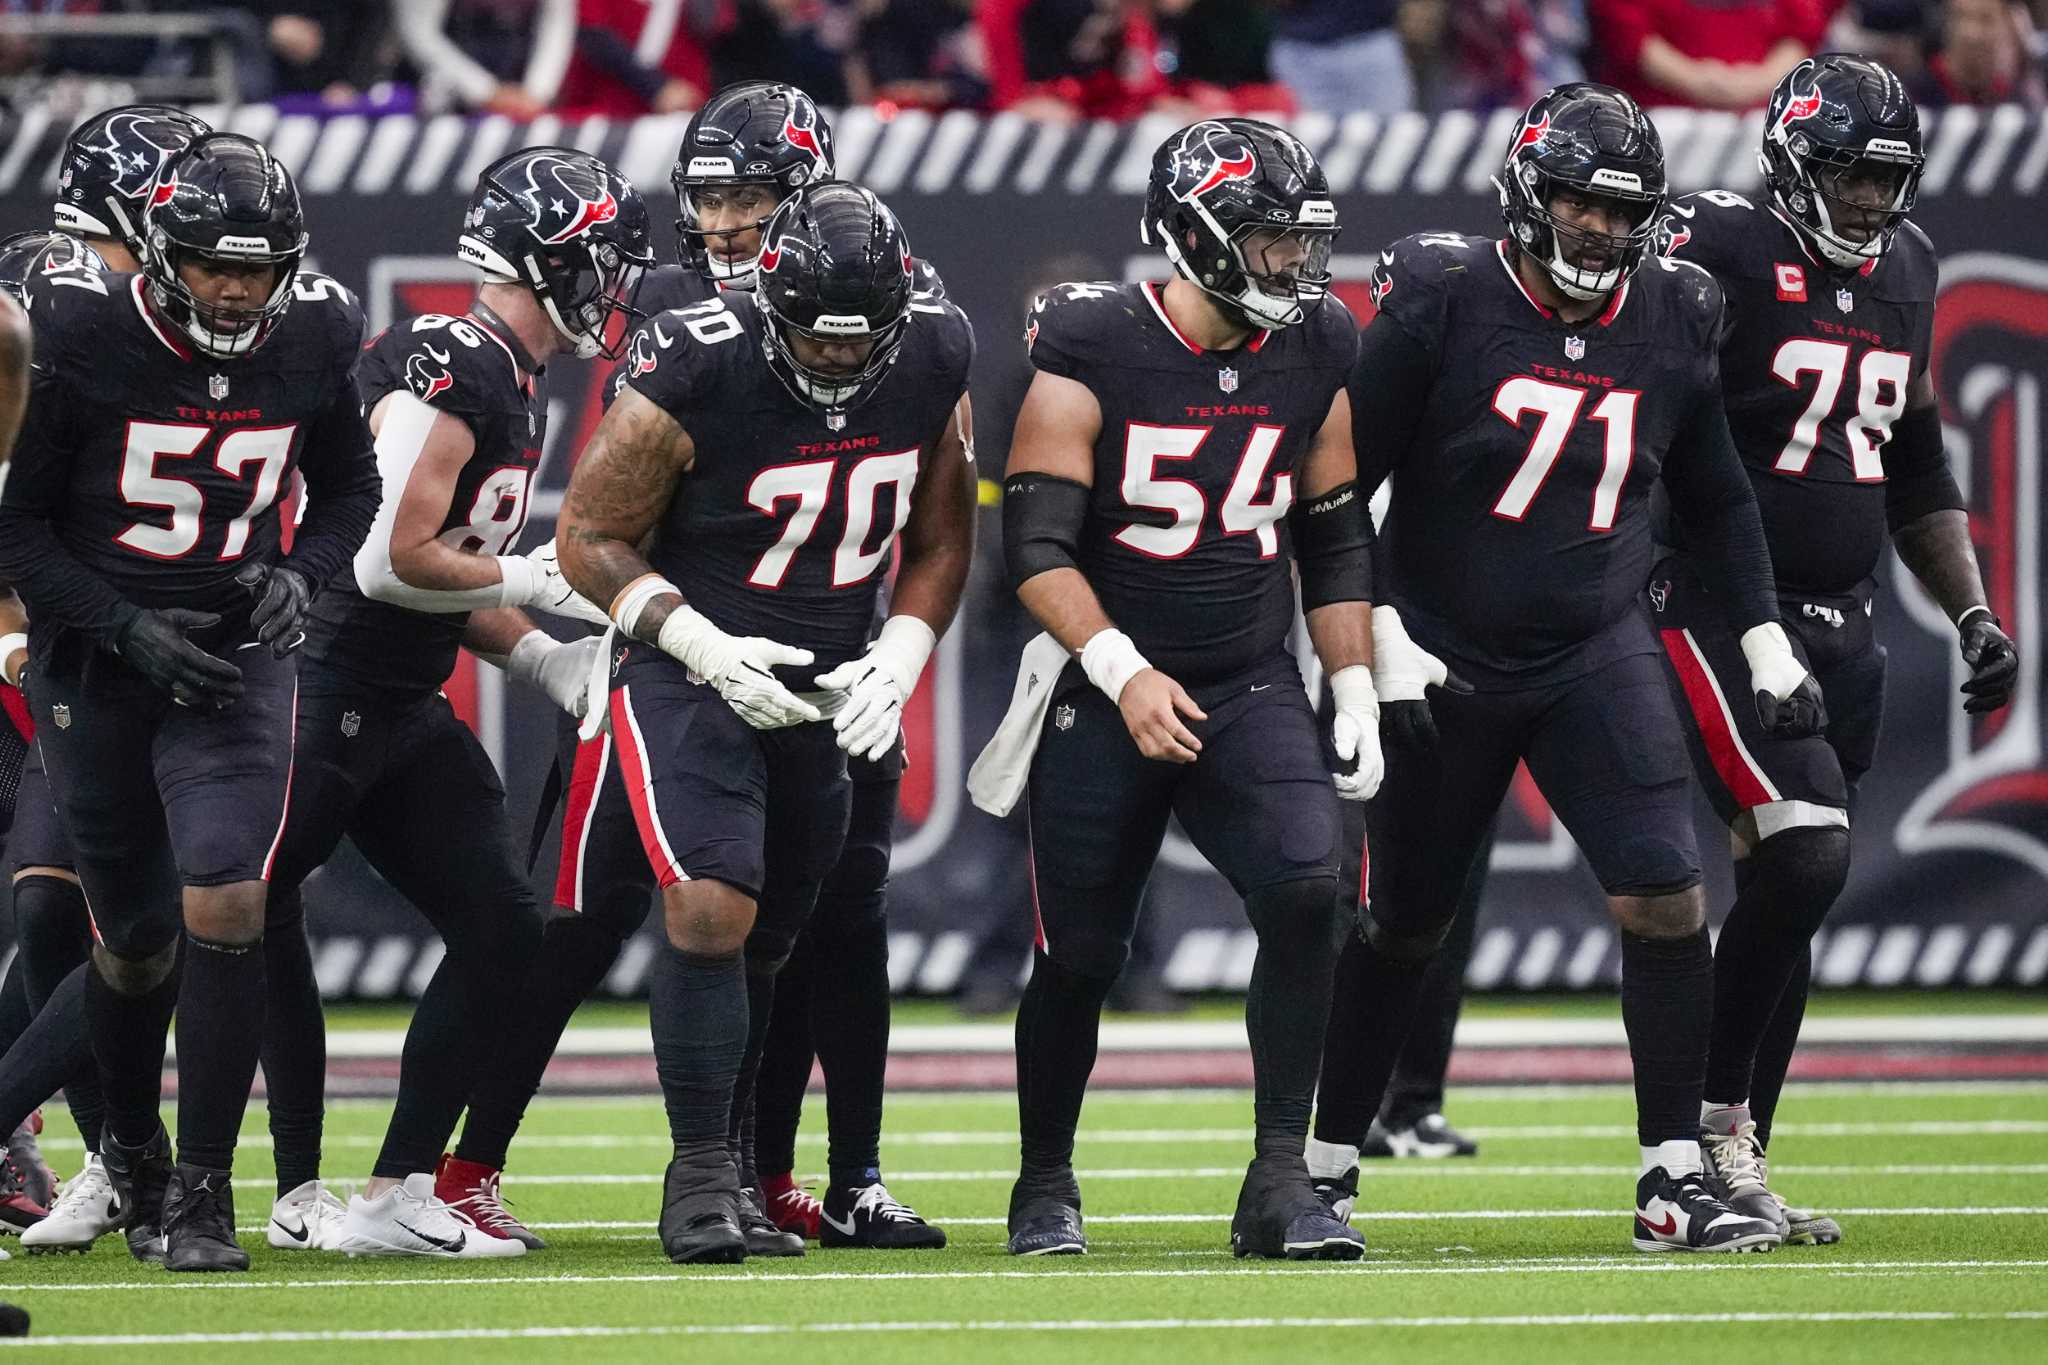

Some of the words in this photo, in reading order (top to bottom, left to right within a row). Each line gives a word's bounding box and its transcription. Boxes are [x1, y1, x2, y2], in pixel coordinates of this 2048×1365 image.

[1600, 173, 1638, 183] TEXANS
[1777, 265, 1803, 292] C
[1811, 319, 1881, 345] TEXANS
[1530, 363, 1616, 388] TEXANS
[1185, 404, 1271, 418] TEXANS
[1768, 336, 1912, 483] 78
[796, 436, 881, 456] TEXANS
[1490, 375, 1643, 532] 71
[112, 418, 297, 561] 57
[1109, 419, 1296, 559] 54
[745, 445, 922, 589] 70
